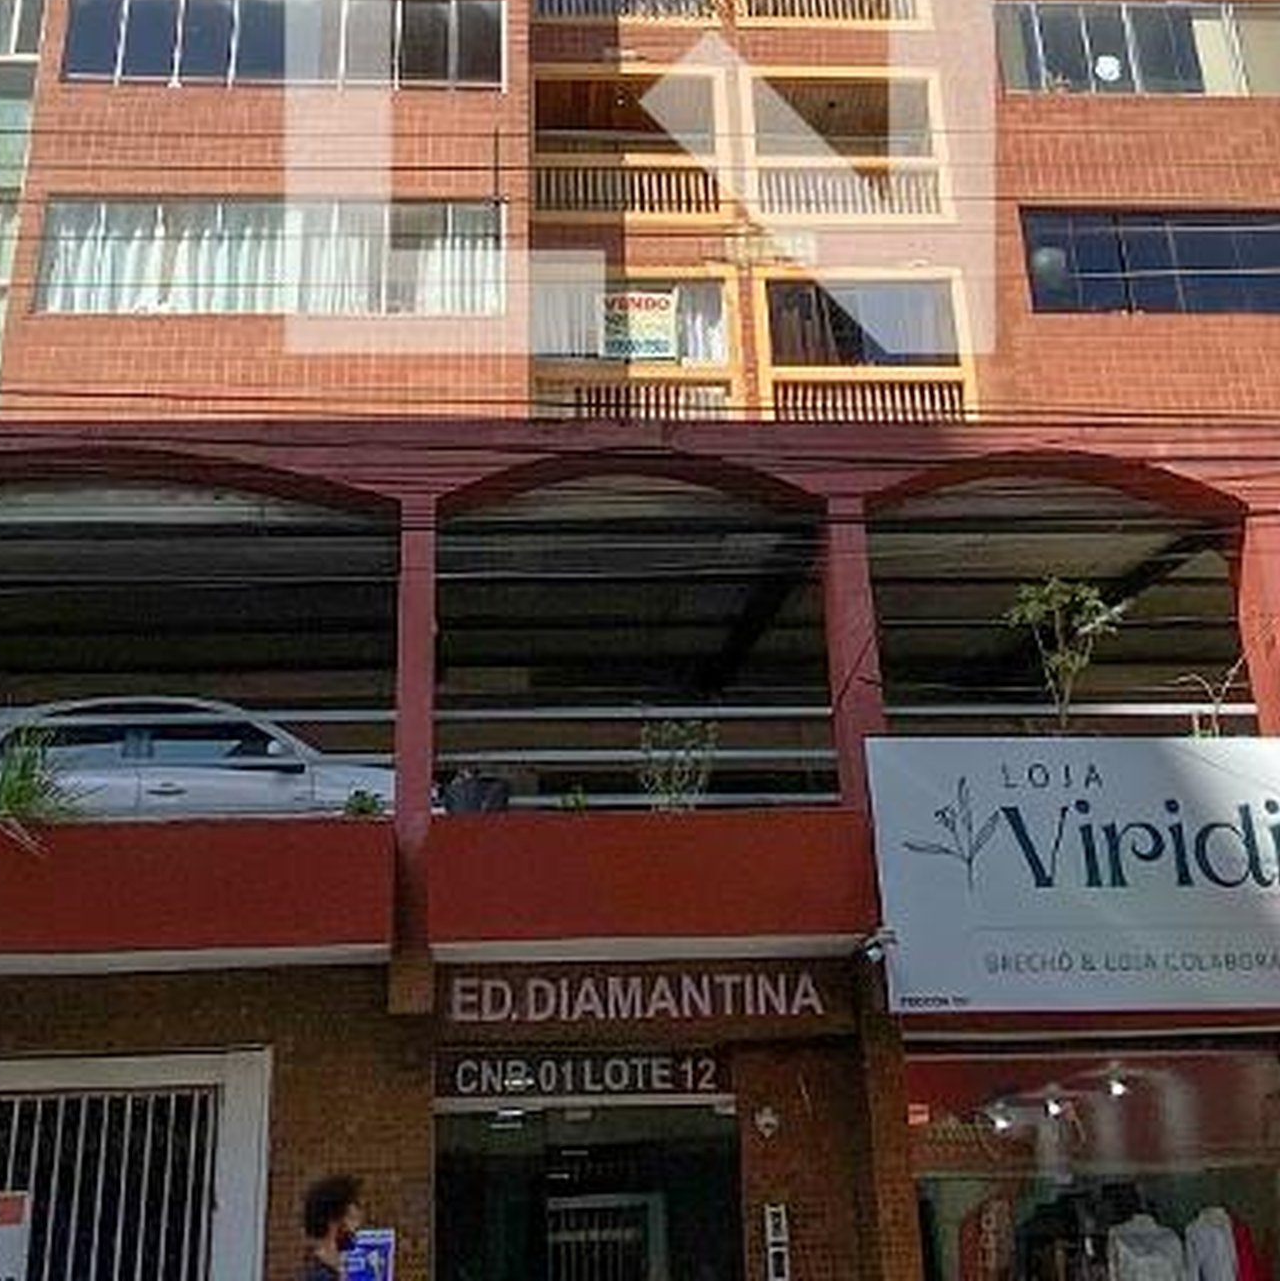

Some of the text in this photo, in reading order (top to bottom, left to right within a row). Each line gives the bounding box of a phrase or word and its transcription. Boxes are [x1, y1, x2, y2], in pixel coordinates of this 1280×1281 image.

[604, 297, 671, 312] VENDO
[1001, 762, 1105, 789] LOJA
[538, 1059, 574, 1092] 01
[583, 1058, 675, 1091] LOTE
[681, 1056, 717, 1090] 12
